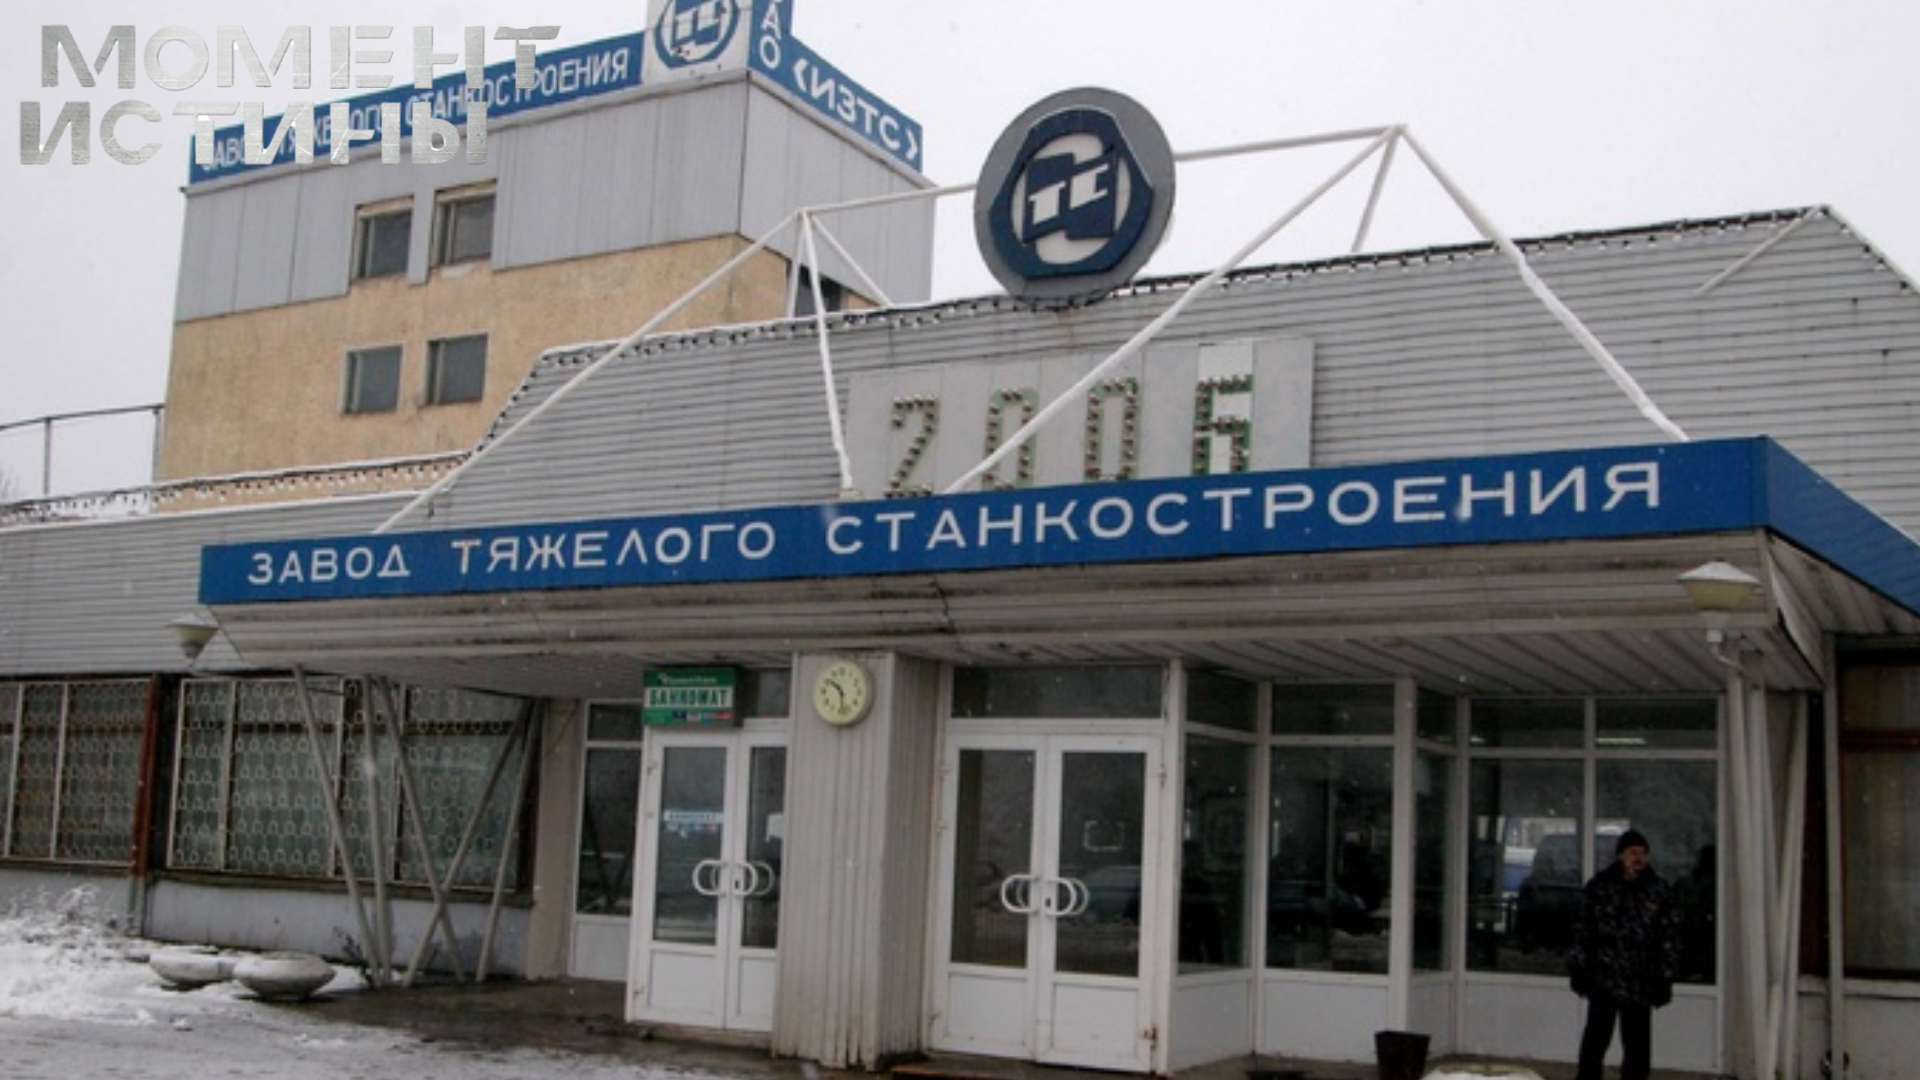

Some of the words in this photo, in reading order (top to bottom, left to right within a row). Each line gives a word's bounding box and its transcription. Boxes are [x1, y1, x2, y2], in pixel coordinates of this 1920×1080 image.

[247, 544, 411, 585] ЗАВОД
[451, 521, 776, 574] ТЯЖЕЛОГО
[825, 461, 1661, 555] СТАНКОСТРОЕНИЯ
[649, 688, 729, 707] БАНКОМАТ
